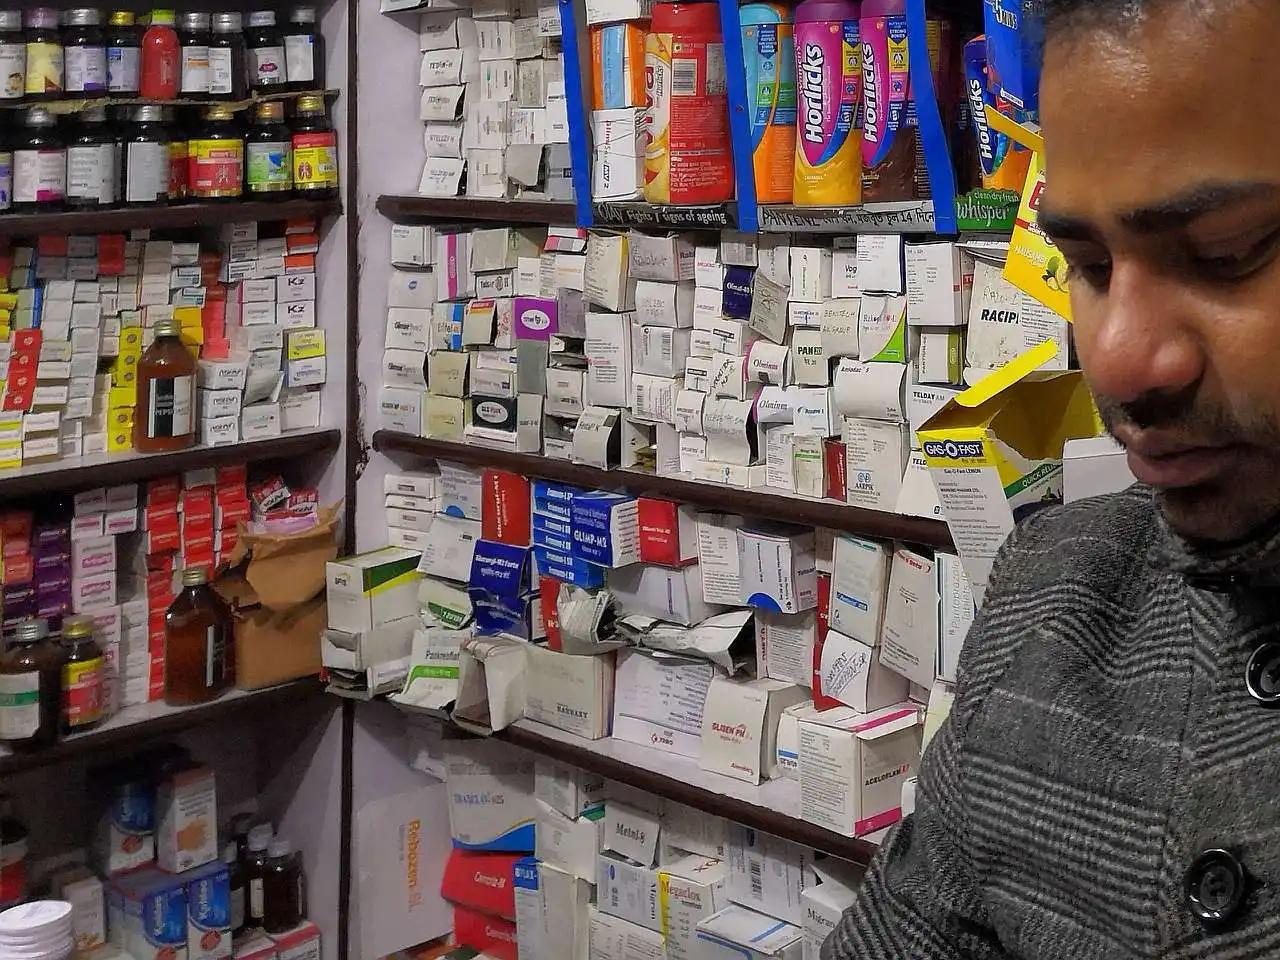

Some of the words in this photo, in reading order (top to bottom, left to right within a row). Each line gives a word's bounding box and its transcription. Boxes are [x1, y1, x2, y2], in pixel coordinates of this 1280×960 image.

[804, 42, 824, 144] Horlicks
[863, 42, 878, 143] Horlicks
[969, 79, 992, 159] Horlicks
[697, 210, 726, 224] ageing
[956, 199, 1009, 221] whisper
[913, 391, 935, 400] TELDAY
